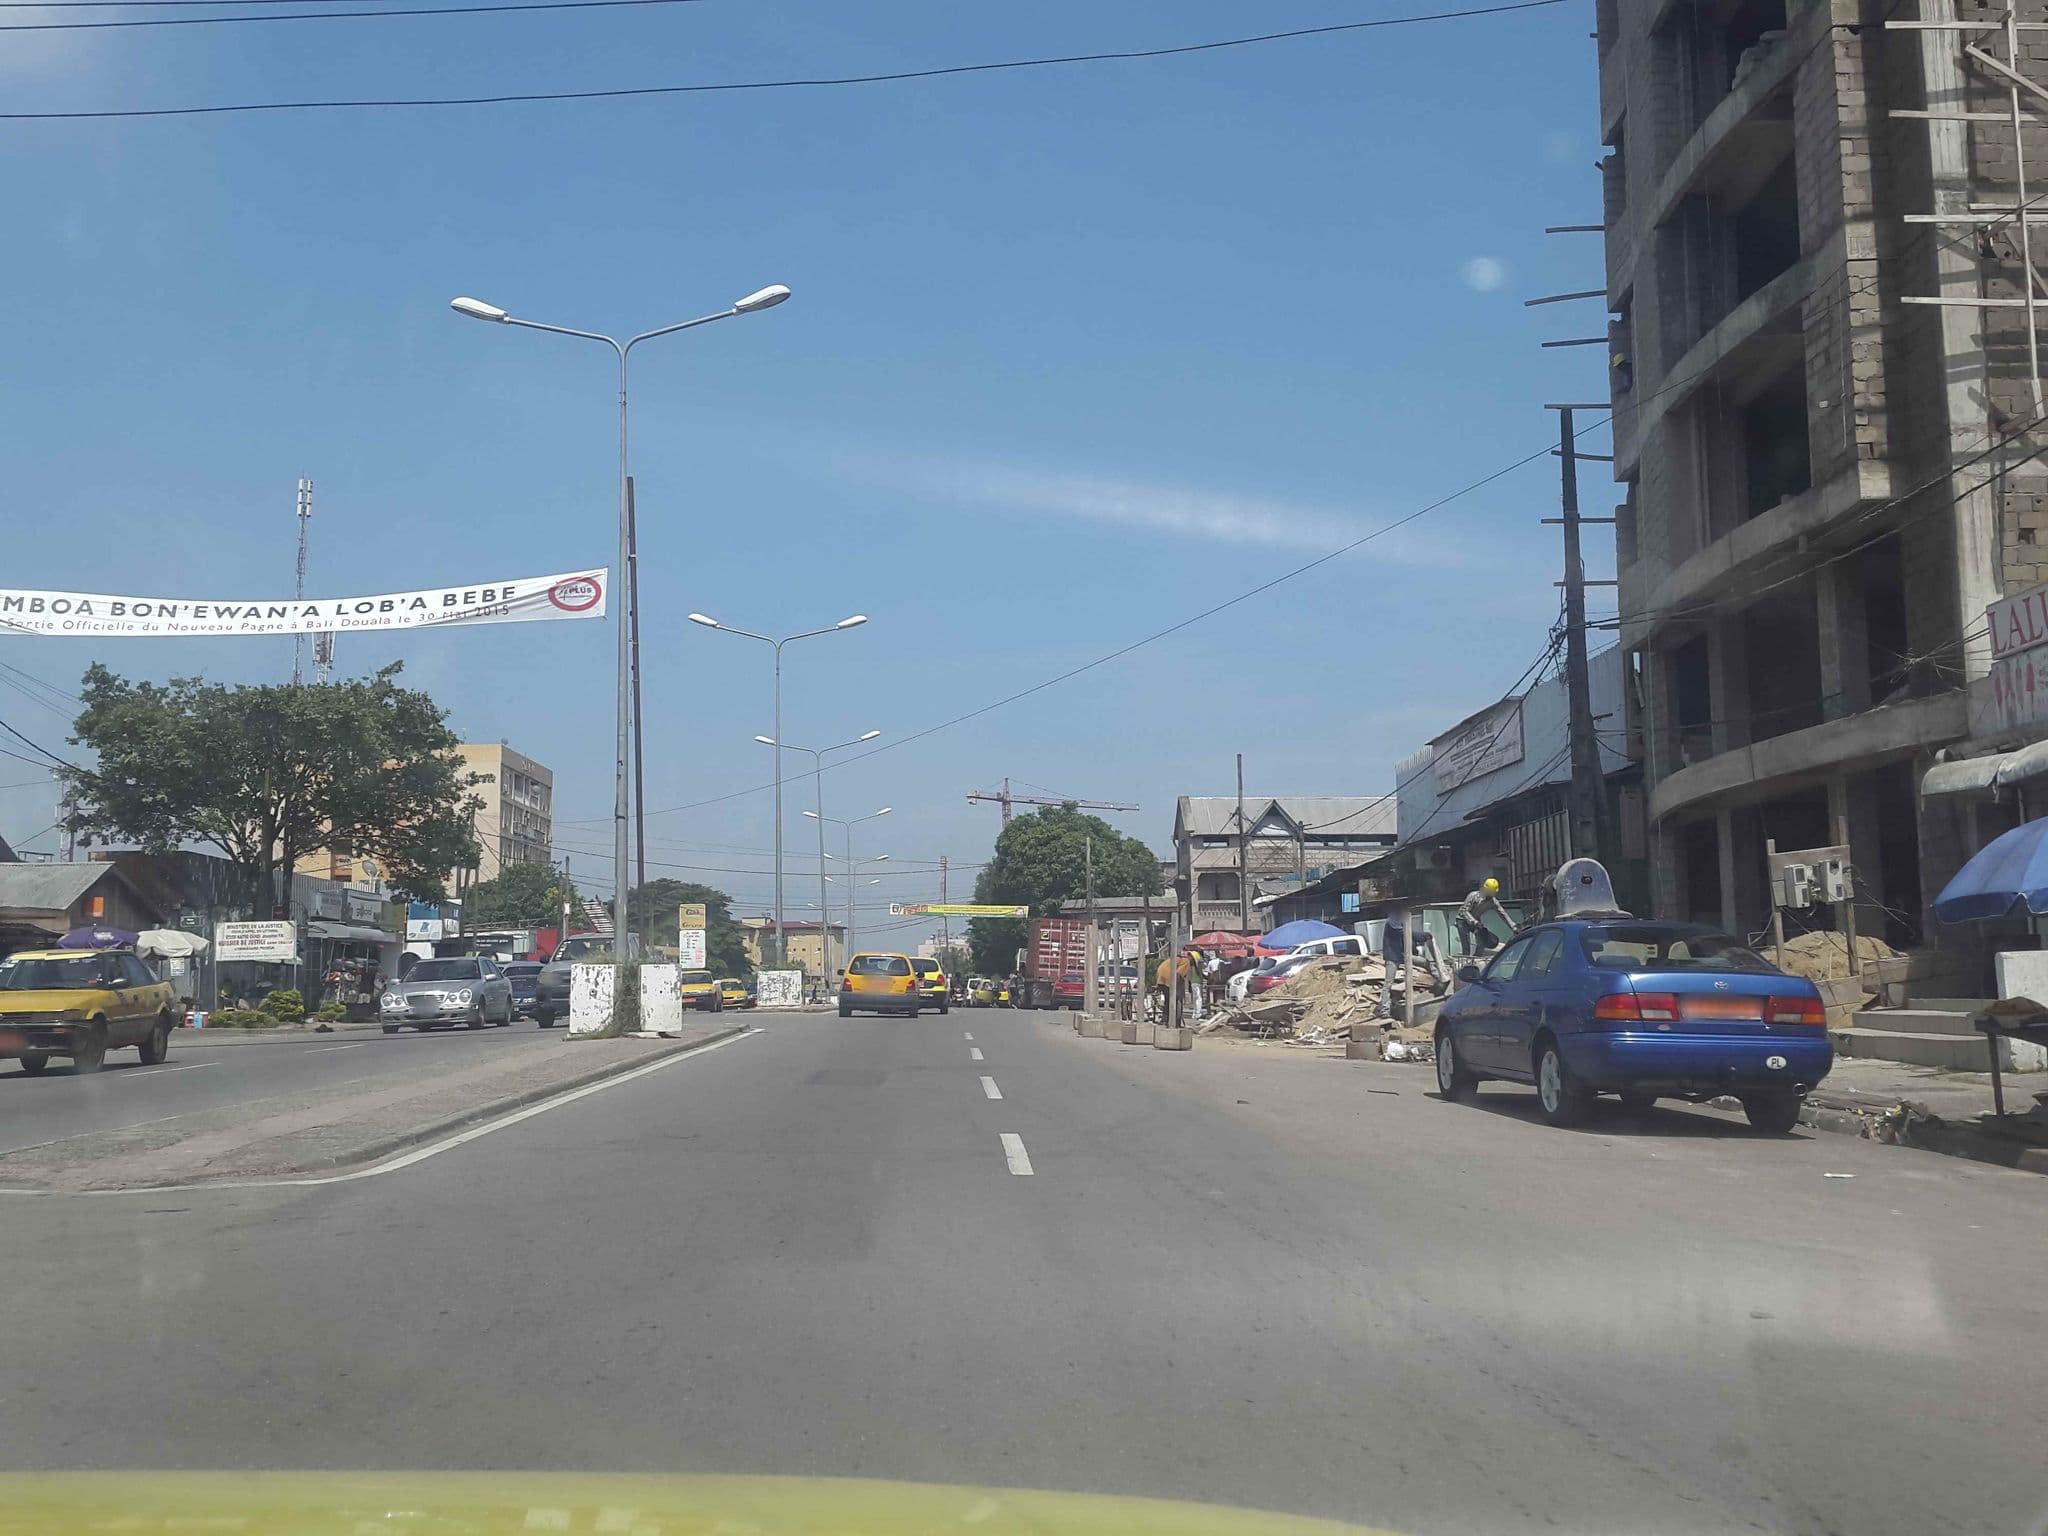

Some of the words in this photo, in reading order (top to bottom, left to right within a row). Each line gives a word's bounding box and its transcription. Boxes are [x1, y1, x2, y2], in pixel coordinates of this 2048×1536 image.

[3, 596, 94, 616] MBOA
[110, 602, 320, 620] BON'EWAN'A
[336, 597, 427, 616] LOB'A
[443, 586, 516, 607] BEBE
[7, 618, 54, 630] Sortie
[62, 620, 134, 631] Officielle
[142, 622, 159, 631] du
[167, 623, 233, 631] Nouveau
[241, 622, 284, 633] Pagne
[306, 620, 333, 629] Bali
[341, 616, 391, 628] Douala
[399, 615, 411, 624] le
[419, 612, 435, 622] 30
[475, 604, 509, 617] 2015
